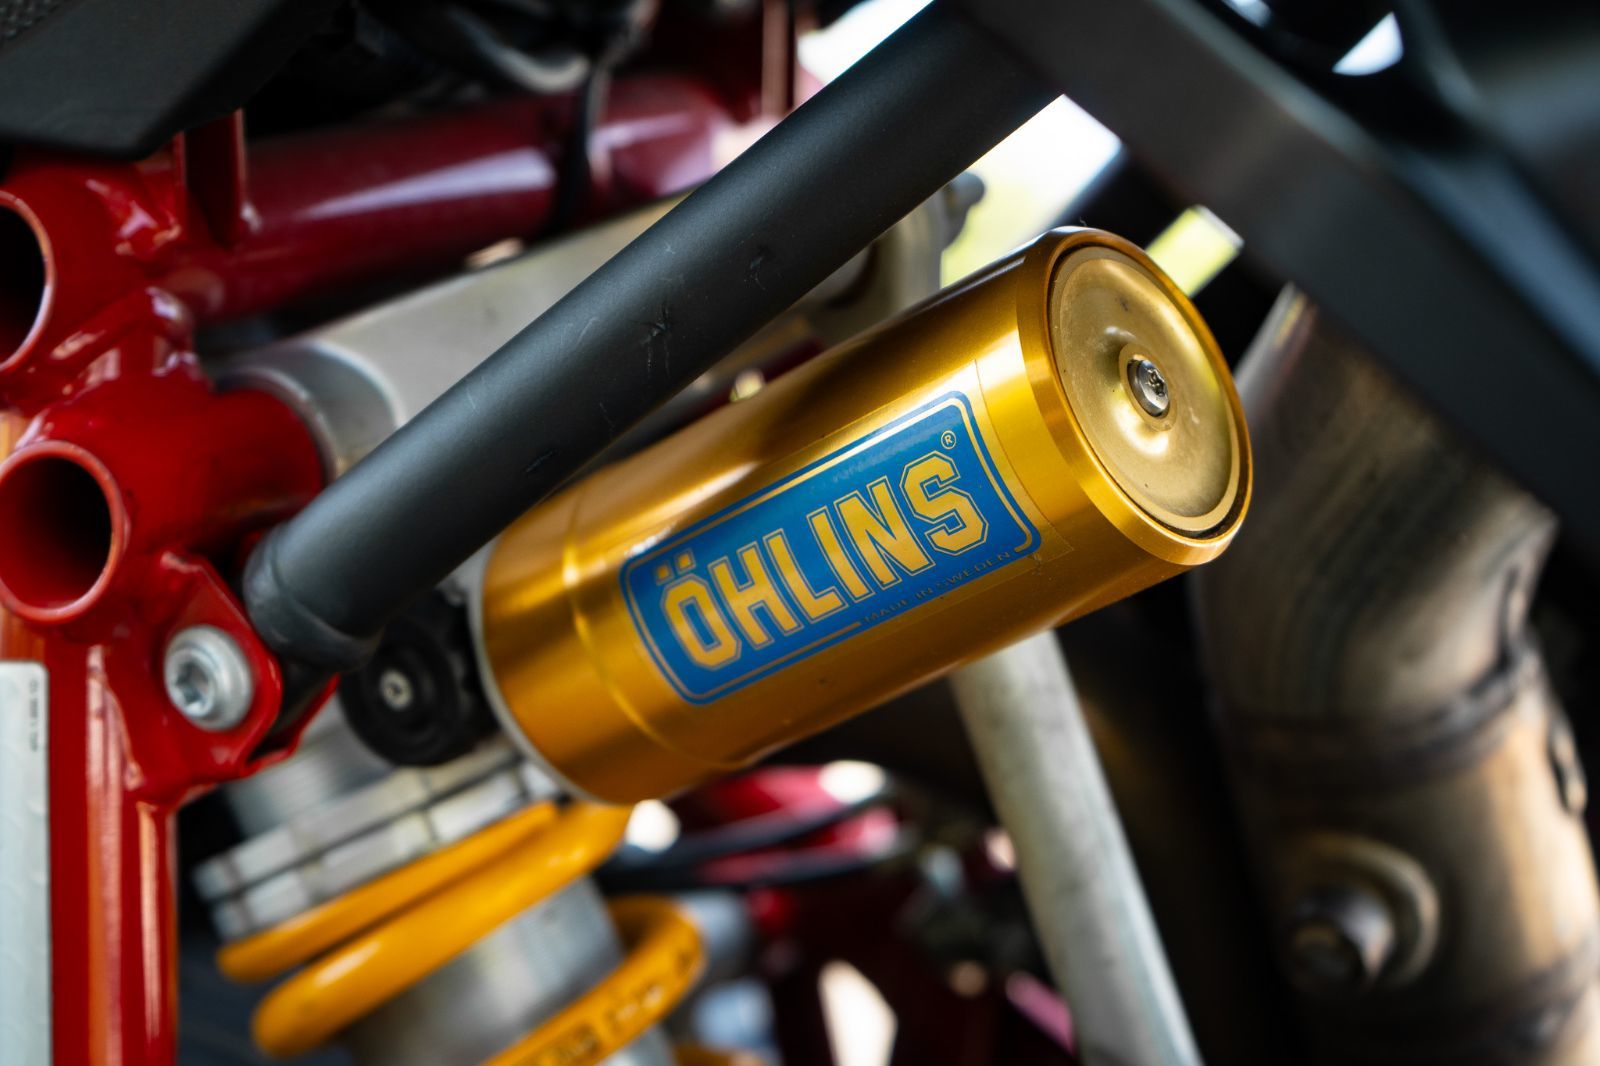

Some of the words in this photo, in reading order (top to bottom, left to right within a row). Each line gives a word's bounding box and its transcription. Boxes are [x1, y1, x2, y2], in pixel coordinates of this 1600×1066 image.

[654, 450, 989, 672] ÖHLINS
[864, 599, 908, 623] MADE
[916, 587, 933, 600] IN
[936, 551, 1010, 589] SWEDEN
